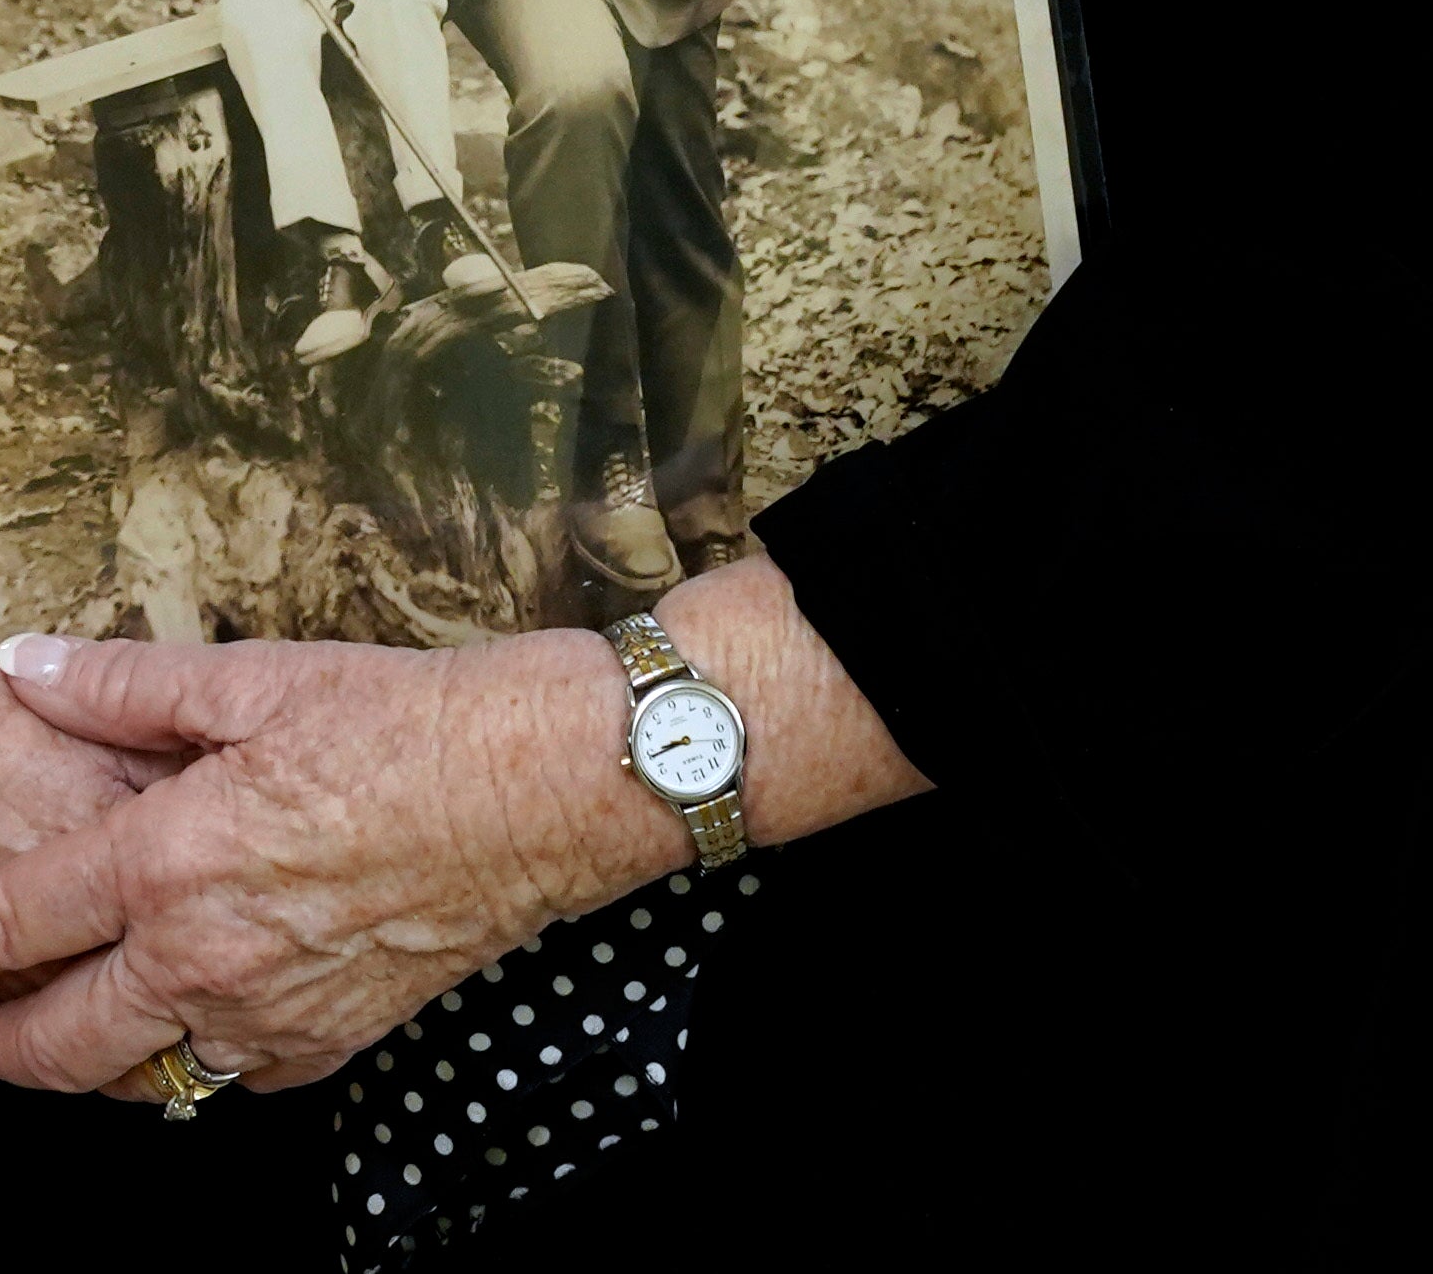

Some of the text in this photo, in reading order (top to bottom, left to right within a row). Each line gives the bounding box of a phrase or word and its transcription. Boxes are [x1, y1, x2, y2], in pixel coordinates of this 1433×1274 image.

[667, 700, 676, 709] 6
[687, 698, 696, 712] 7
[652, 712, 662, 725] 5
[702, 706, 713, 719] 8
[716, 722, 725, 733] 9
[712, 738, 728, 753] 10
[657, 762, 668, 776] 2
[707, 756, 720, 770] 11
[676, 771, 684, 783] 1
[691, 767, 706, 782] 12
